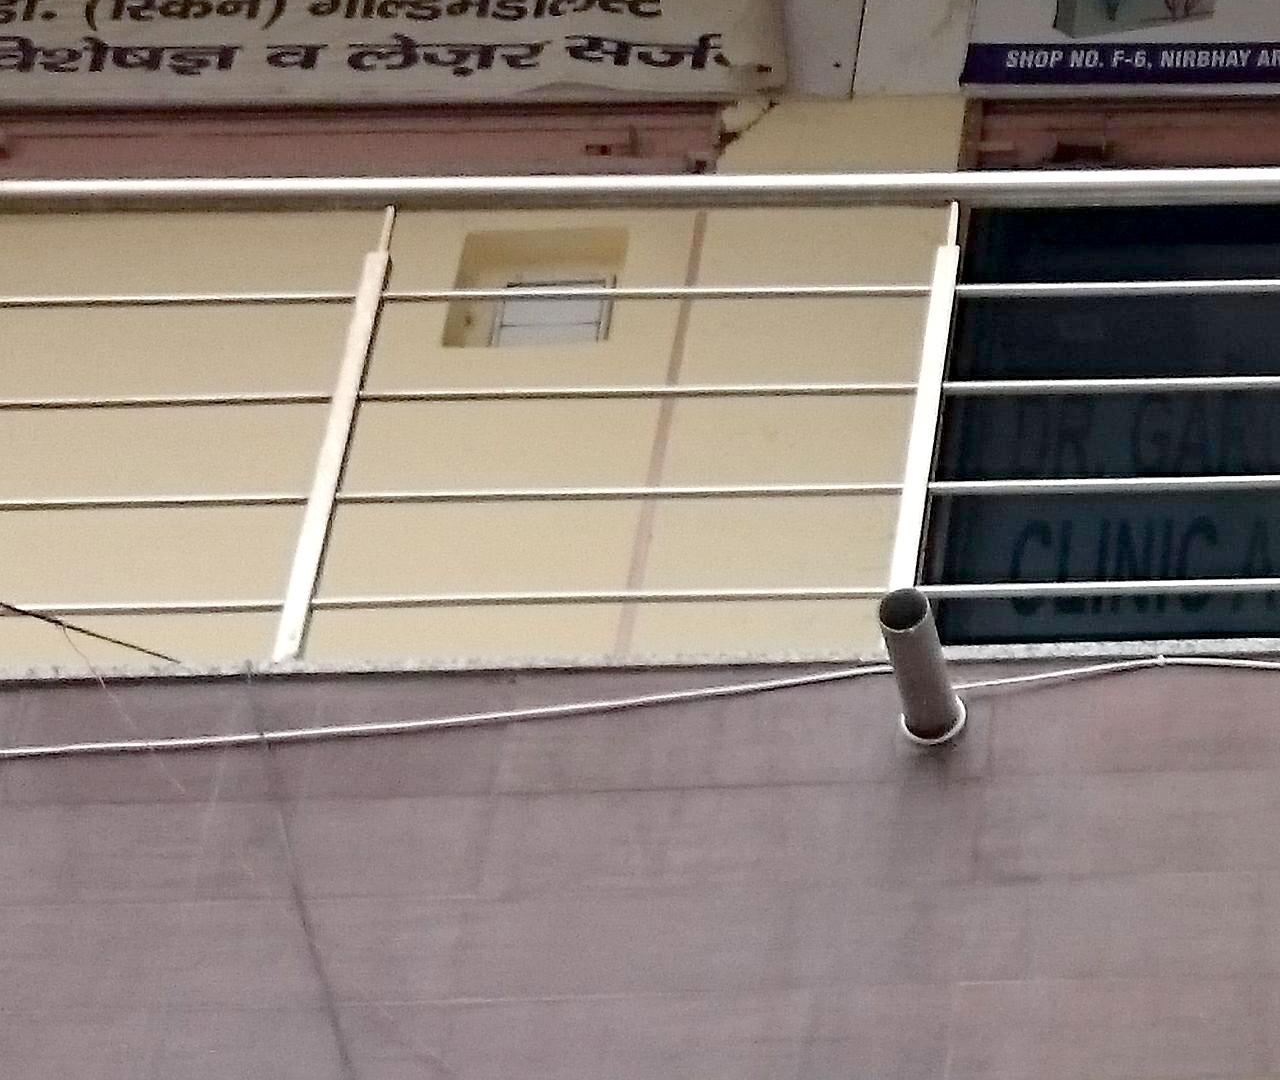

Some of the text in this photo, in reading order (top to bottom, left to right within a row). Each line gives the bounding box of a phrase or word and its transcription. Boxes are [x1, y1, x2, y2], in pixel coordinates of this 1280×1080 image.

[266, 43, 329, 70] व
[1006, 49, 1062, 69] SHOP
[1069, 49, 1103, 69] NO.
[1111, 49, 1153, 72] F-6,
[1160, 49, 1250, 69] NIRBHAY
